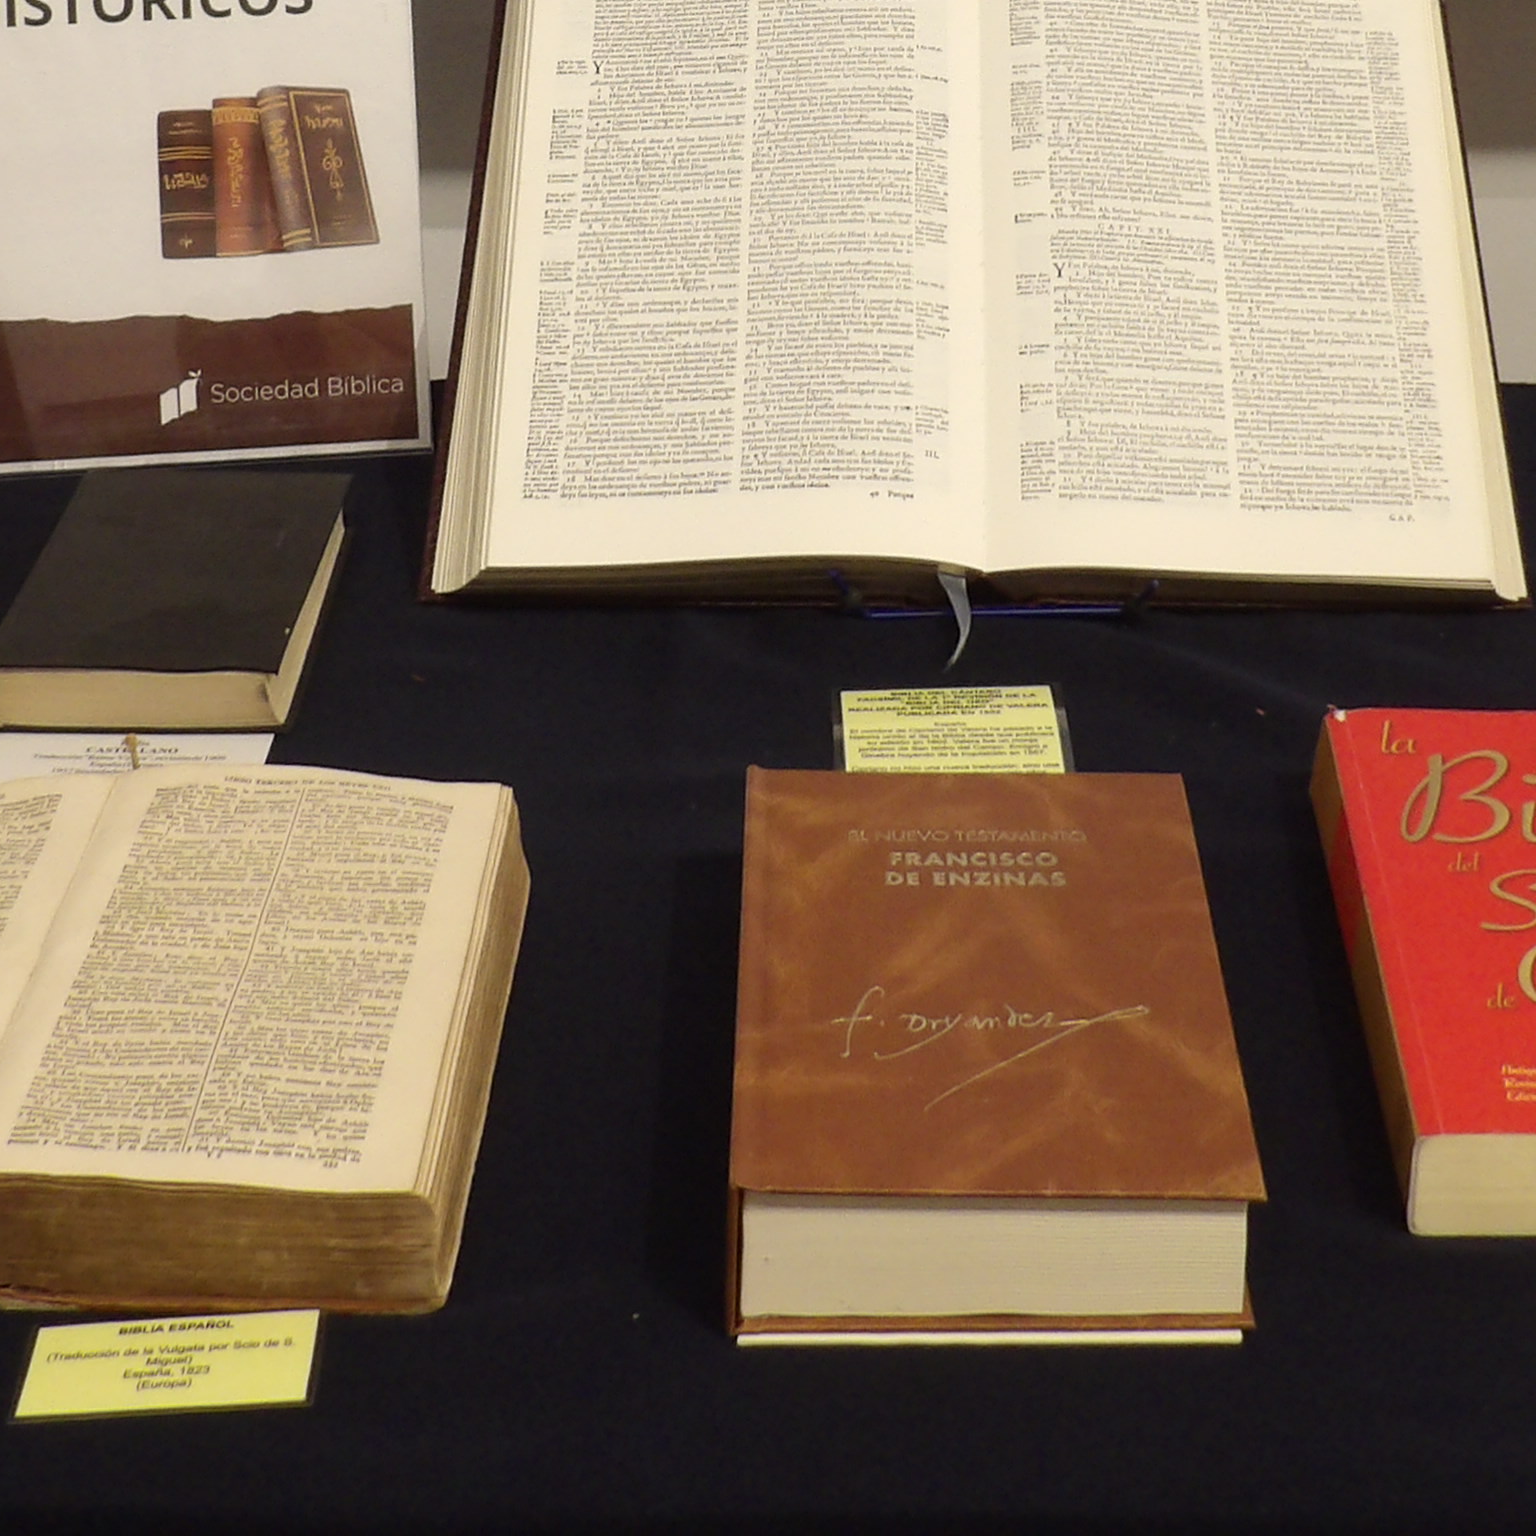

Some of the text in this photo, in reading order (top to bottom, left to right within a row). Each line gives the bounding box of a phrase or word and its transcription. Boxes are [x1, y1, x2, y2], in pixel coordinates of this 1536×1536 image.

[210, 375, 404, 405] Sociedad Bíblica
[1381, 720, 1416, 755] la
[848, 830, 1087, 842] EL NUEVO TESTAMENTO
[890, 852, 1058, 866] FRANCISCO
[1447, 853, 1479, 873] del
[885, 872, 1066, 886] DE ENZINAS
[1487, 983, 1516, 1009] de
